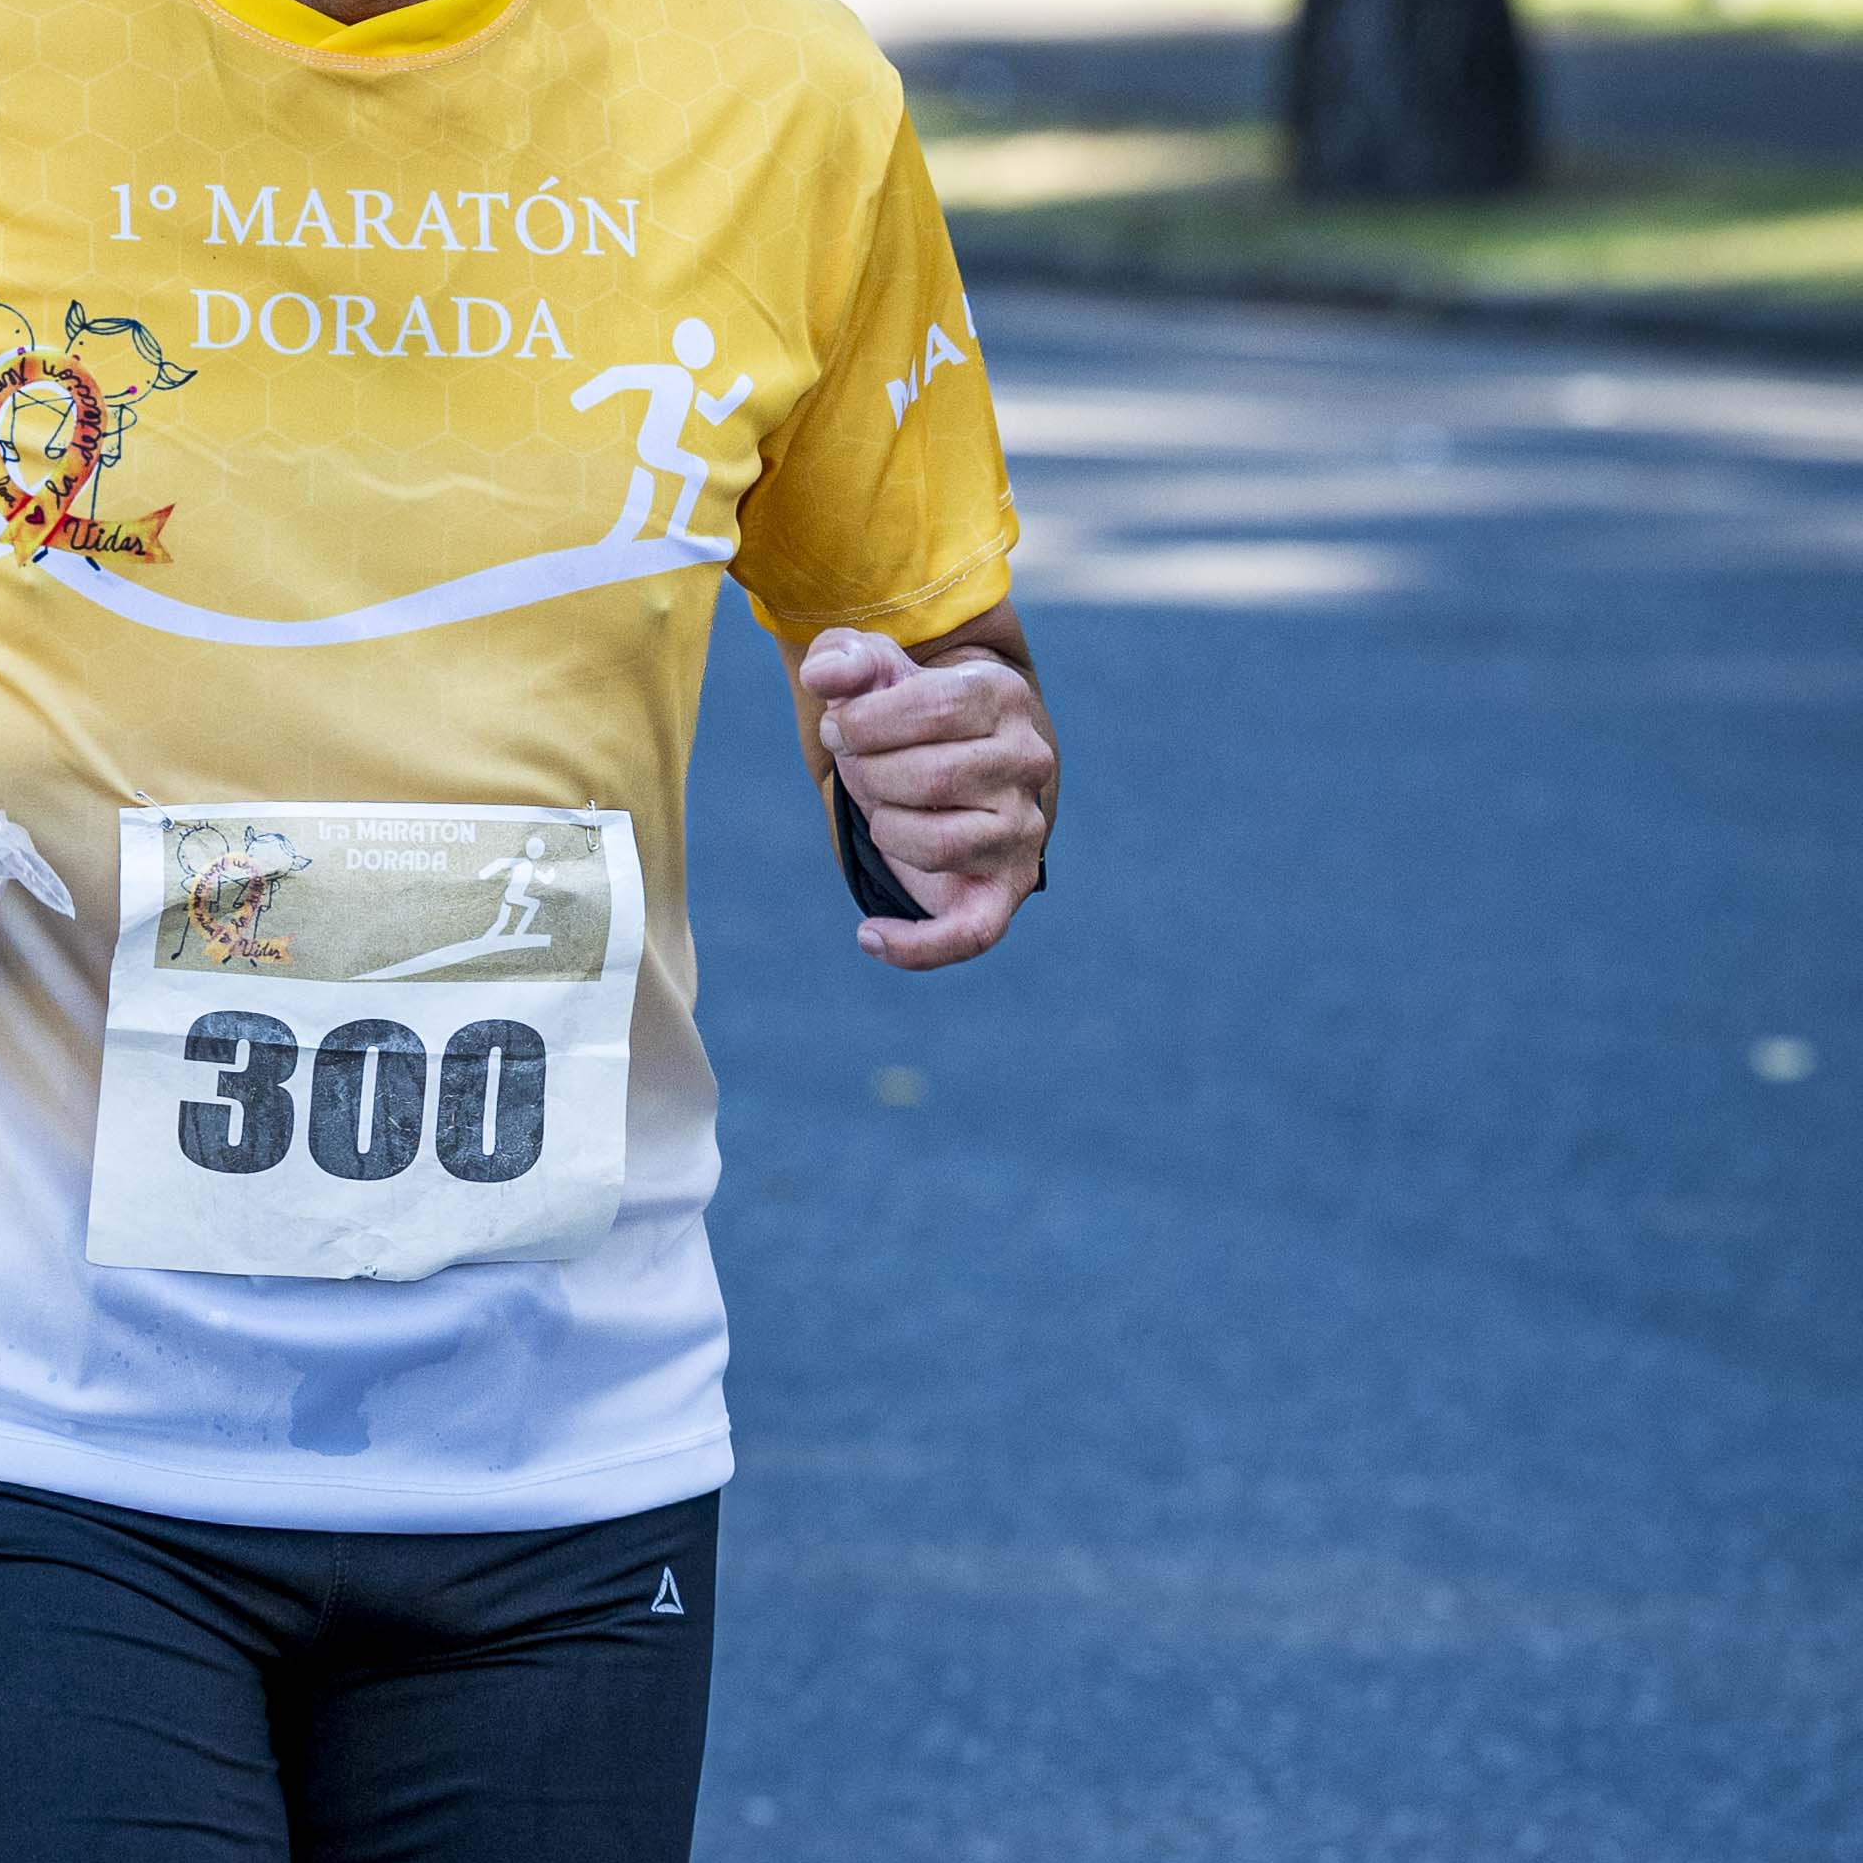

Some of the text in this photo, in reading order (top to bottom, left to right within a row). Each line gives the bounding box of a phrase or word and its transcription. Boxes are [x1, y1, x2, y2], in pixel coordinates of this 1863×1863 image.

[203, 175, 641, 258] MARATÓN
[189, 288, 575, 360] DORADA
[62, 516, 147, 557] Vidas
[344, 847, 449, 873] DORADA
[177, 1009, 548, 1184] 300
